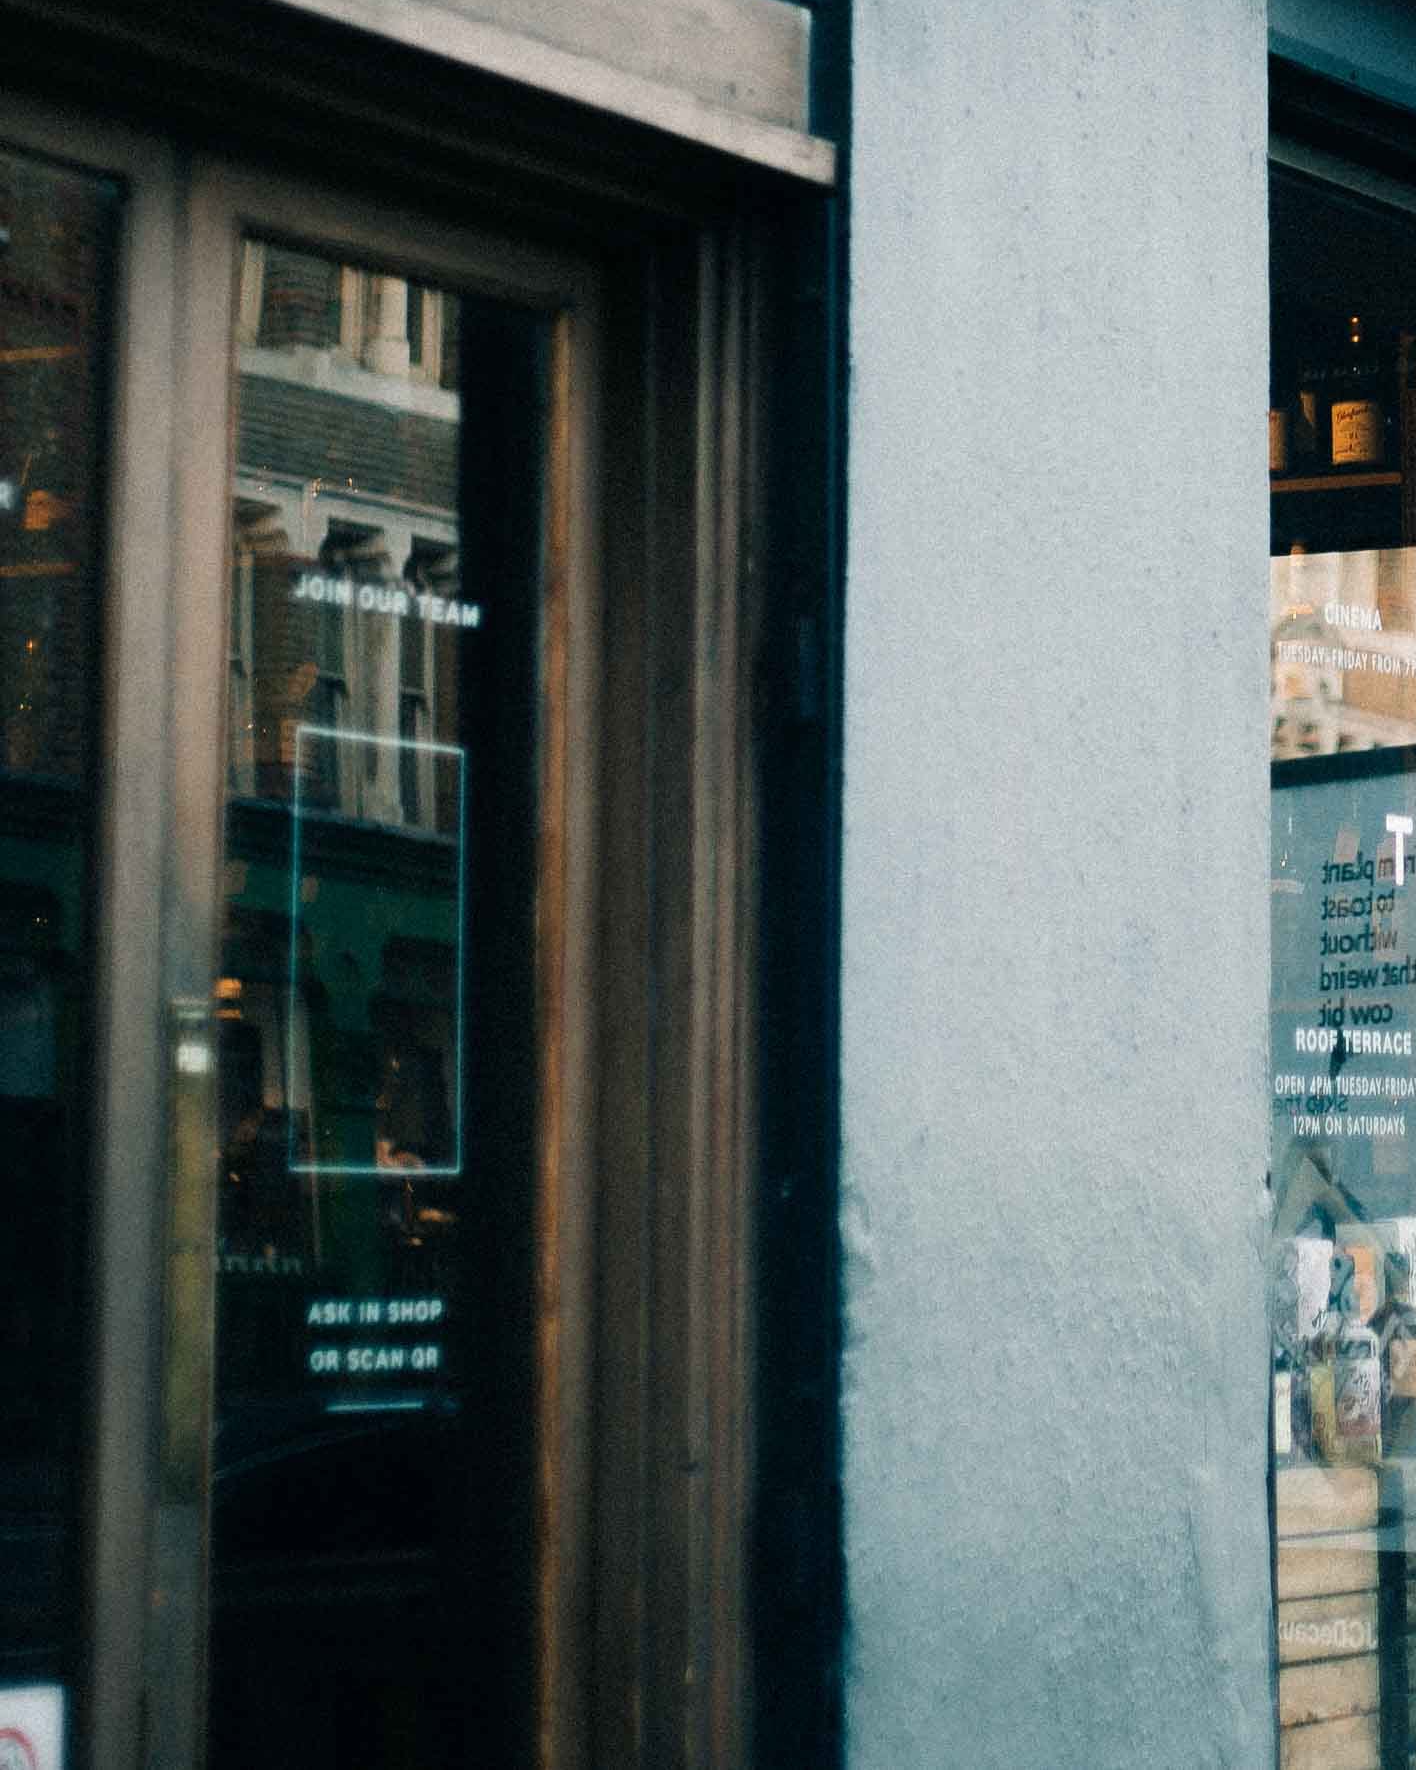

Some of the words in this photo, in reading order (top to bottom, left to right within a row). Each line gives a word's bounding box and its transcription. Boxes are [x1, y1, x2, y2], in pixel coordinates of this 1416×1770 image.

[295, 575, 353, 606] JOIN
[359, 584, 409, 616] OUR
[416, 593, 480, 627] TEAM
[1324, 602, 1382, 630] CINEMA
[1372, 654, 1401, 677] FROM
[1296, 1027, 1338, 1053] ROOF
[1343, 1030, 1412, 1055] TERRACE
[1275, 1075, 1305, 1095] OPEN
[1310, 1076, 1332, 1097] 4PM
[1293, 1115, 1321, 1136] 12PM
[1325, 1115, 1342, 1135] ON
[1347, 1115, 1406, 1136] SATURDAYS
[308, 1302, 351, 1325] ASK
[359, 1301, 380, 1323] IN
[388, 1299, 443, 1323] SHOP
[310, 1348, 340, 1372] OR
[347, 1347, 404, 1371] SCAN
[411, 1345, 438, 1370] QR
